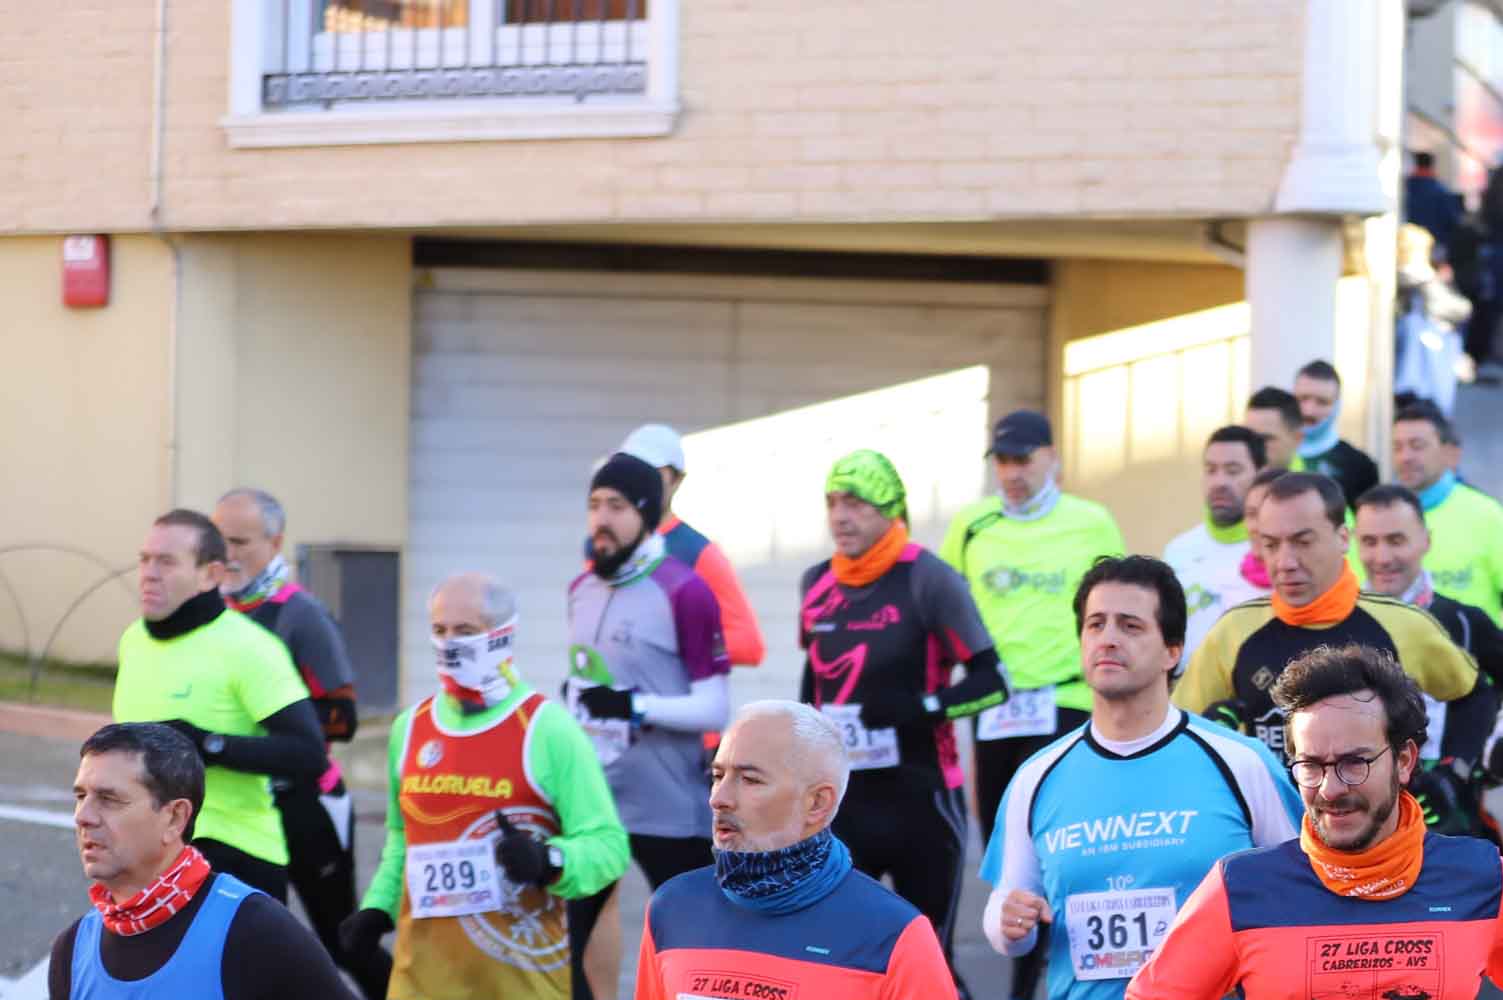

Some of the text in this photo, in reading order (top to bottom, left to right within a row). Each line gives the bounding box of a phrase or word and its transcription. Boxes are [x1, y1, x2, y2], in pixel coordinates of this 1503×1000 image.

[1045, 810, 1198, 854] VIEWNEXT
[423, 861, 477, 893] 289
[1086, 911, 1149, 950] 361
[1321, 940, 1433, 958] 27 LIGA CROSS
[1322, 957, 1394, 971] CABRERIZOS
[1406, 956, 1428, 967] AVS
[692, 977, 708, 992] 27
[710, 979, 740, 995] LIGA
